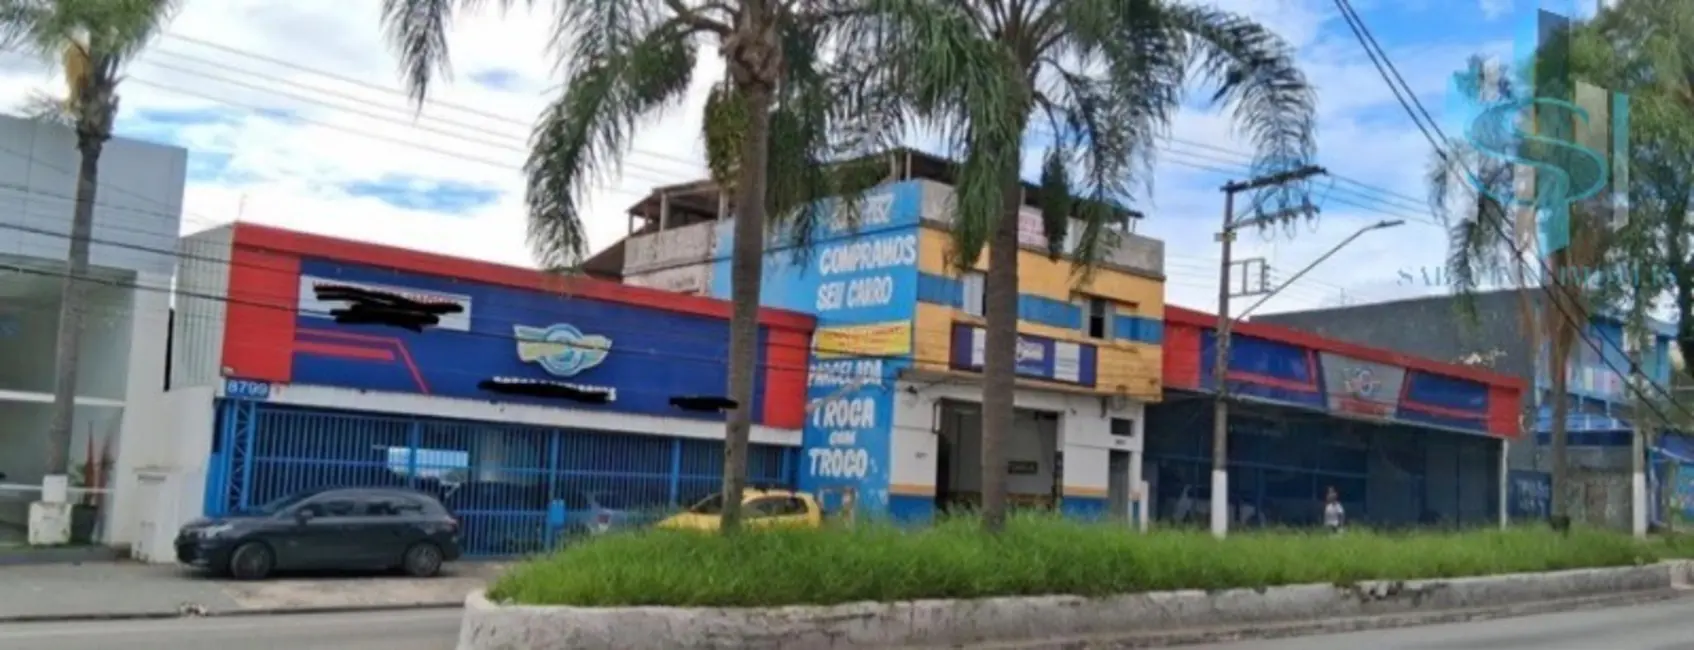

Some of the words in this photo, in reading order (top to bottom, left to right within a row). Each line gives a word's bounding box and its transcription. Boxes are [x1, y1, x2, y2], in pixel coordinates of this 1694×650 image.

[819, 234, 917, 276] COMPRAMOS
[816, 281, 846, 311] SEU
[846, 275, 893, 308] CARRO
[227, 379, 269, 396] 8799
[811, 397, 876, 429] TROCA
[808, 448, 870, 480] TROCO
